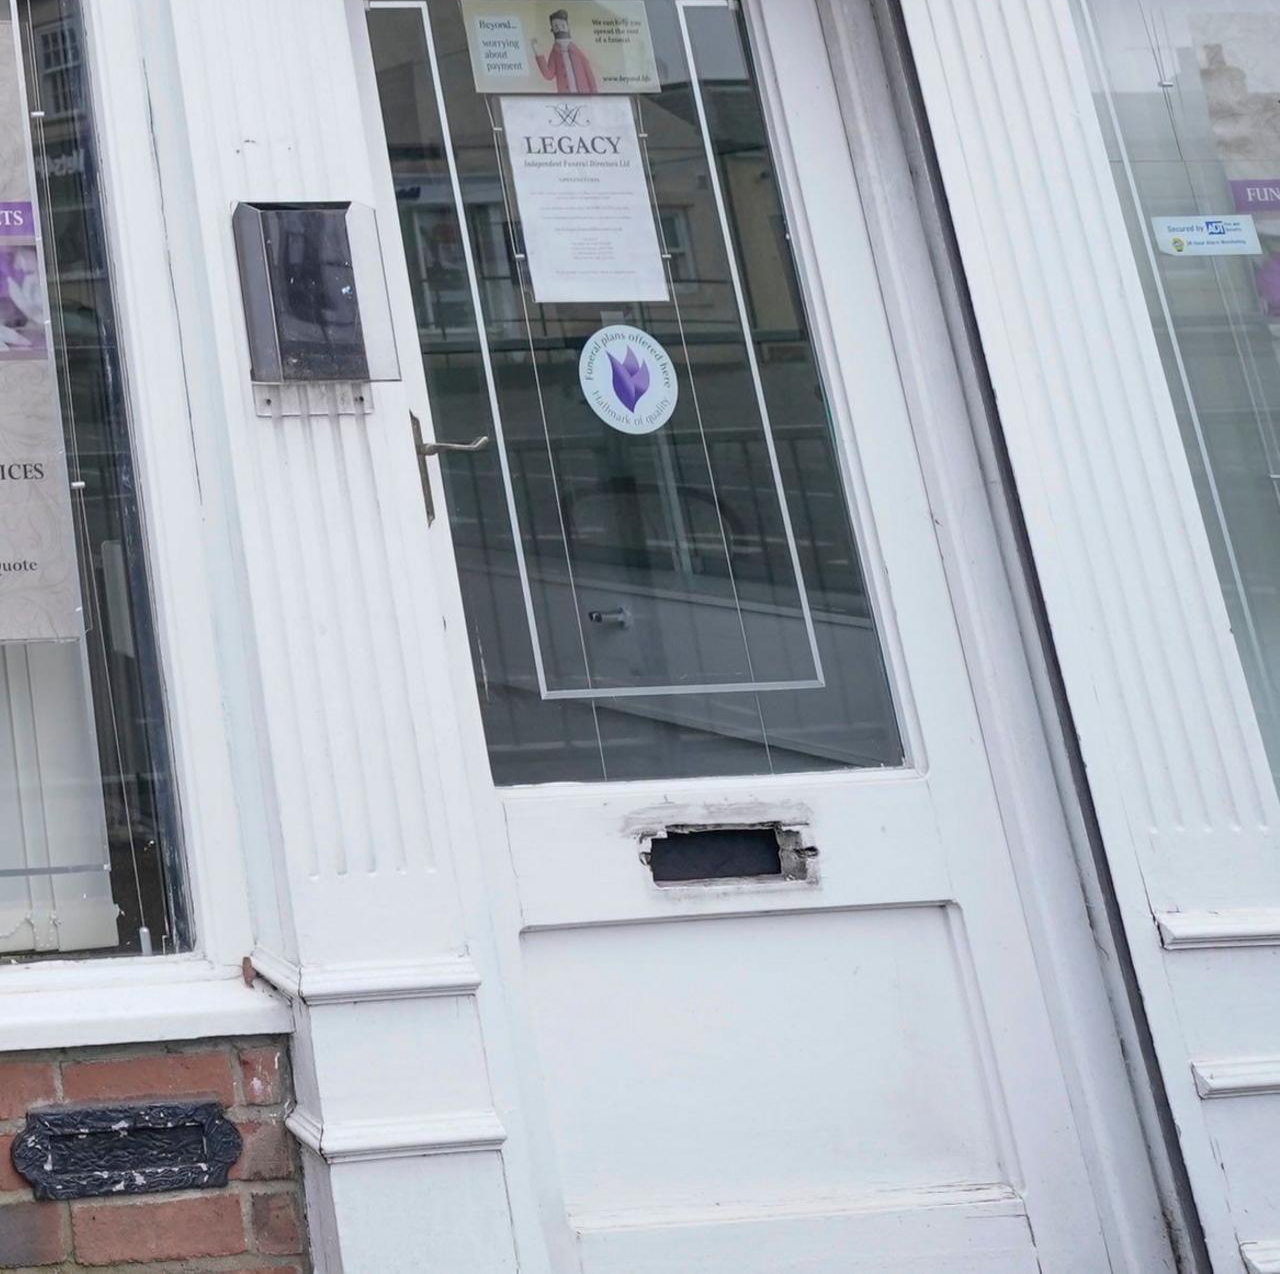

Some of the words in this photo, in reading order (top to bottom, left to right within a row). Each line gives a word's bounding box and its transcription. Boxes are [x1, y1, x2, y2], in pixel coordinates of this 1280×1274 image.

[482, 39, 520, 50] worrying
[484, 50, 507, 59] about
[486, 62, 523, 72] payment
[524, 136, 622, 155] LEGACY
[1167, 225, 1195, 233] Secured
[1196, 225, 1204, 233] by
[1206, 222, 1226, 234] ADT
[584, 341, 601, 381] Funeral
[601, 332, 626, 347] plans
[628, 333, 663, 361] offered
[660, 362, 671, 388] here
[592, 390, 631, 424] Hallmark
[634, 417, 643, 426] of
[645, 398, 670, 425] quality
